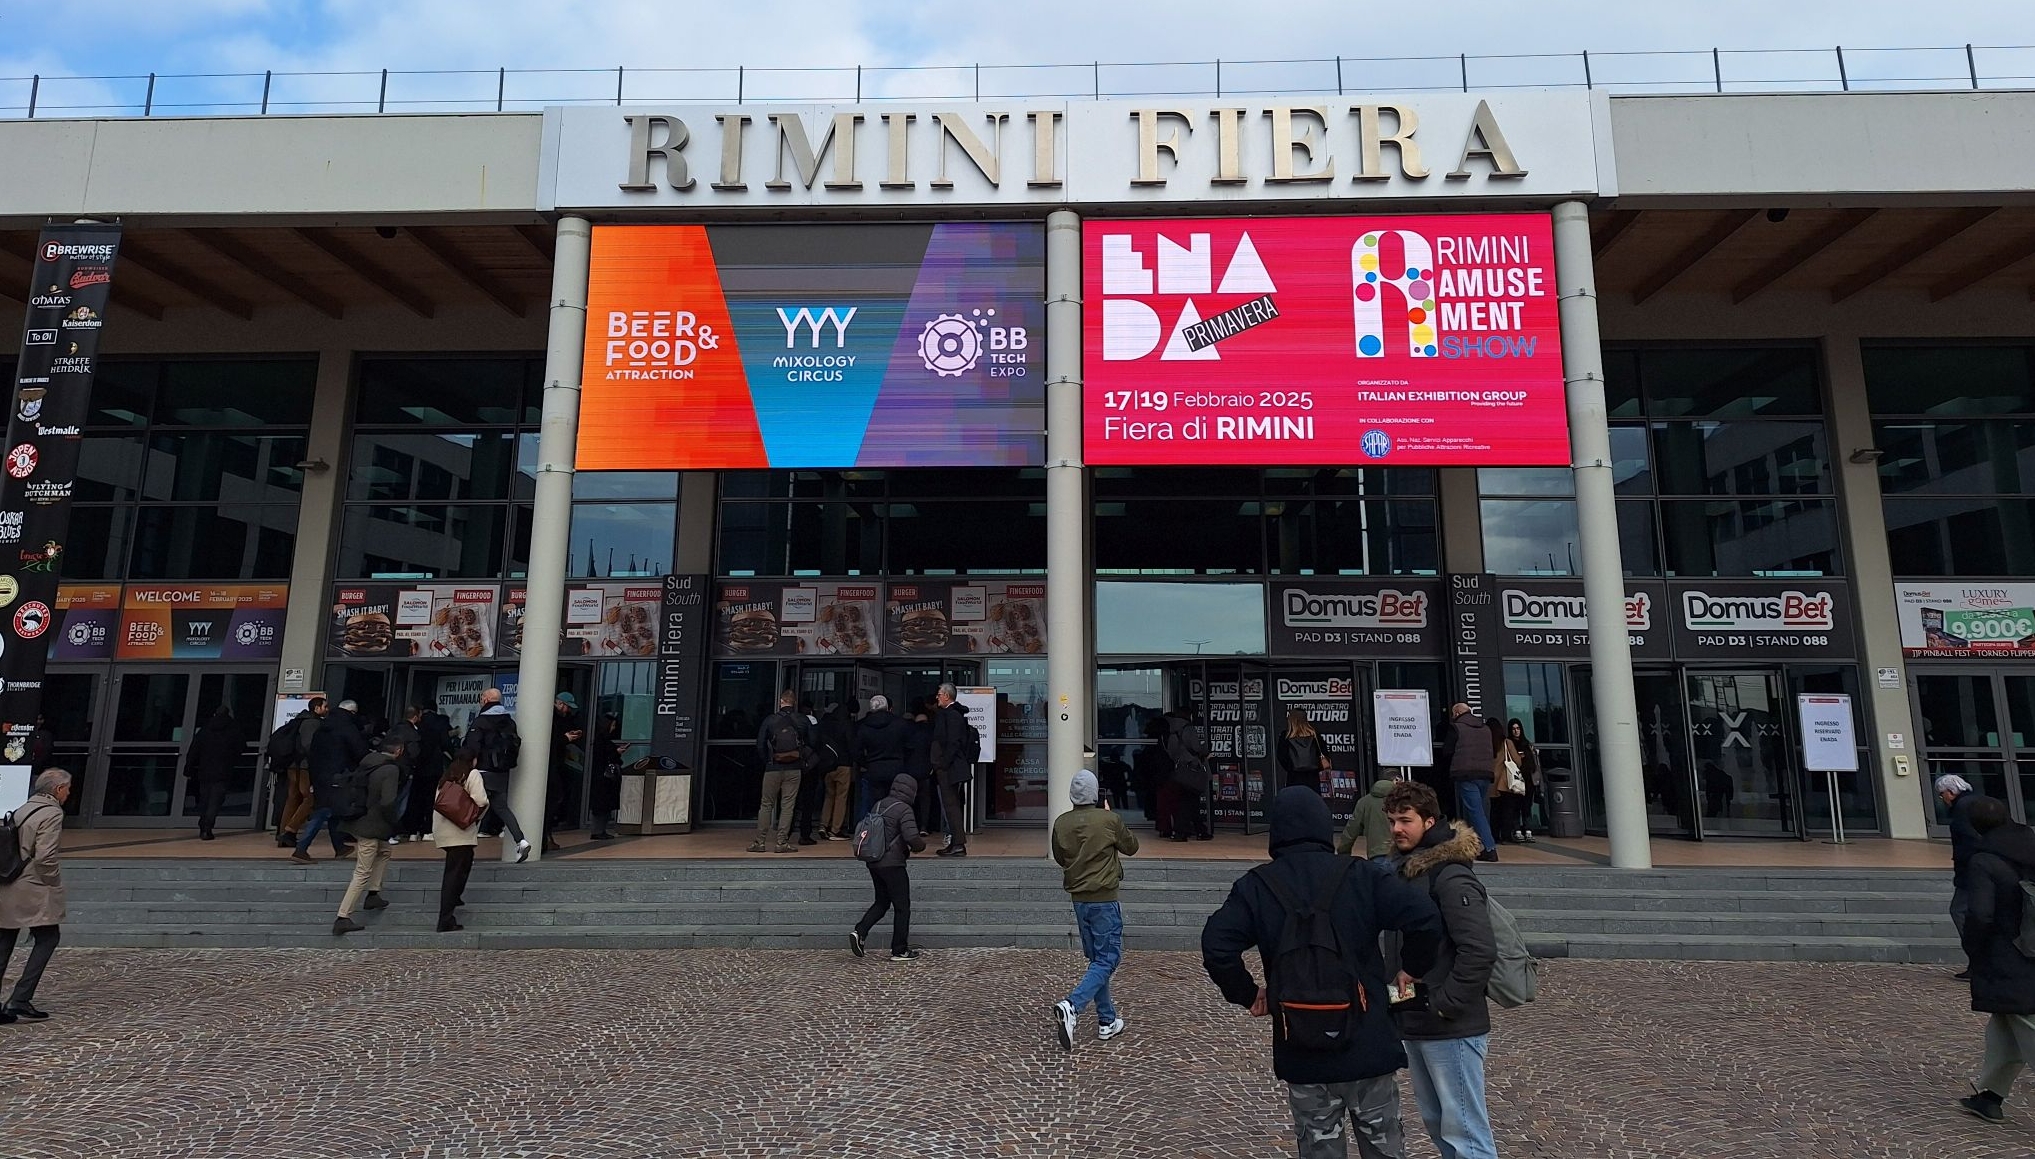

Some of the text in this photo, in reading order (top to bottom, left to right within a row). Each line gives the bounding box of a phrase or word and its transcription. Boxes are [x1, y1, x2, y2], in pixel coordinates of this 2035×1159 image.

[619, 99, 1529, 192] RIMINI FIERA
[57, 245, 113, 254] BREWRISE
[1437, 236, 1529, 265] RIMINI
[1438, 268, 1545, 298] AMUSE
[1440, 301, 1525, 331] MENT
[62, 319, 102, 328] Kaiserdom
[1183, 296, 1278, 351] PRIMAVERA
[608, 311, 719, 349] BEER &
[32, 333, 40, 341] To
[990, 327, 1028, 350] BB
[606, 340, 697, 366] FOOD
[1442, 335, 1537, 359] SHOW
[54, 357, 90, 365] STRAFFE
[773, 355, 856, 368] MIXOLOGY
[990, 353, 1026, 364] TECH
[50, 364, 91, 373] HENDRIK
[606, 369, 694, 380] ATTRACTION
[990, 367, 1026, 377] EXPO
[787, 370, 843, 382] CIRCUS
[1174, 391, 1254, 407] Febbraio
[1259, 391, 1313, 410] 2025
[1357, 391, 1527, 401] ITALIAN EXHIBITION GROUP
[38, 426, 79, 435] Westmalle
[1105, 416, 1314, 440] Fiera di RIMINI
[1363, 432, 1388, 456] SAPAR
[8, 443, 36, 462] JOPEN
[0, 511, 23, 525] OSKAR
[667, 576, 691, 589] Sud
[1453, 575, 1478, 589] Sud
[136, 591, 201, 602] WELCOME
[341, 592, 364, 600] BURGER
[456, 591, 492, 600] FINGERFOOD
[511, 591, 526, 599] BURG
[627, 590, 662, 598] FINGERFOOD
[724, 589, 747, 597] BURGER
[840, 589, 875, 597] FINGERFOOD
[893, 588, 916, 596] BURGER
[1009, 588, 1044, 596] FINGERFOOD
[1455, 591, 1491, 605] South
[1962, 589, 2008, 598] LUXURY
[667, 592, 701, 606] South
[1288, 593, 1422, 617] DomusBet
[337, 604, 389, 619] SMASH IT BABY!
[507, 608, 525, 618] SMAS
[721, 602, 773, 615] SMASH IT BABY!
[891, 601, 943, 615] SMASH IT BABY!
[1688, 596, 1828, 619] DomusBet
[1962, 611, 1974, 619] da
[93, 628, 105, 636] BB
[130, 622, 164, 635] BEER &
[260, 627, 273, 636] BB
[1457, 612, 1478, 656] Fiera
[1952, 619, 2033, 639] 9.900€
[128, 632, 157, 641] FOOD
[1295, 632, 1421, 643] PAD D3 STAND 088
[1515, 634, 1563, 645] PAD D3
[1698, 635, 1828, 646] PAD D3 STAND 088
[657, 612, 684, 715] Rimini Fiera
[462, 680, 483, 691] LAVORI
[1306, 710, 1349, 722] UTURO
